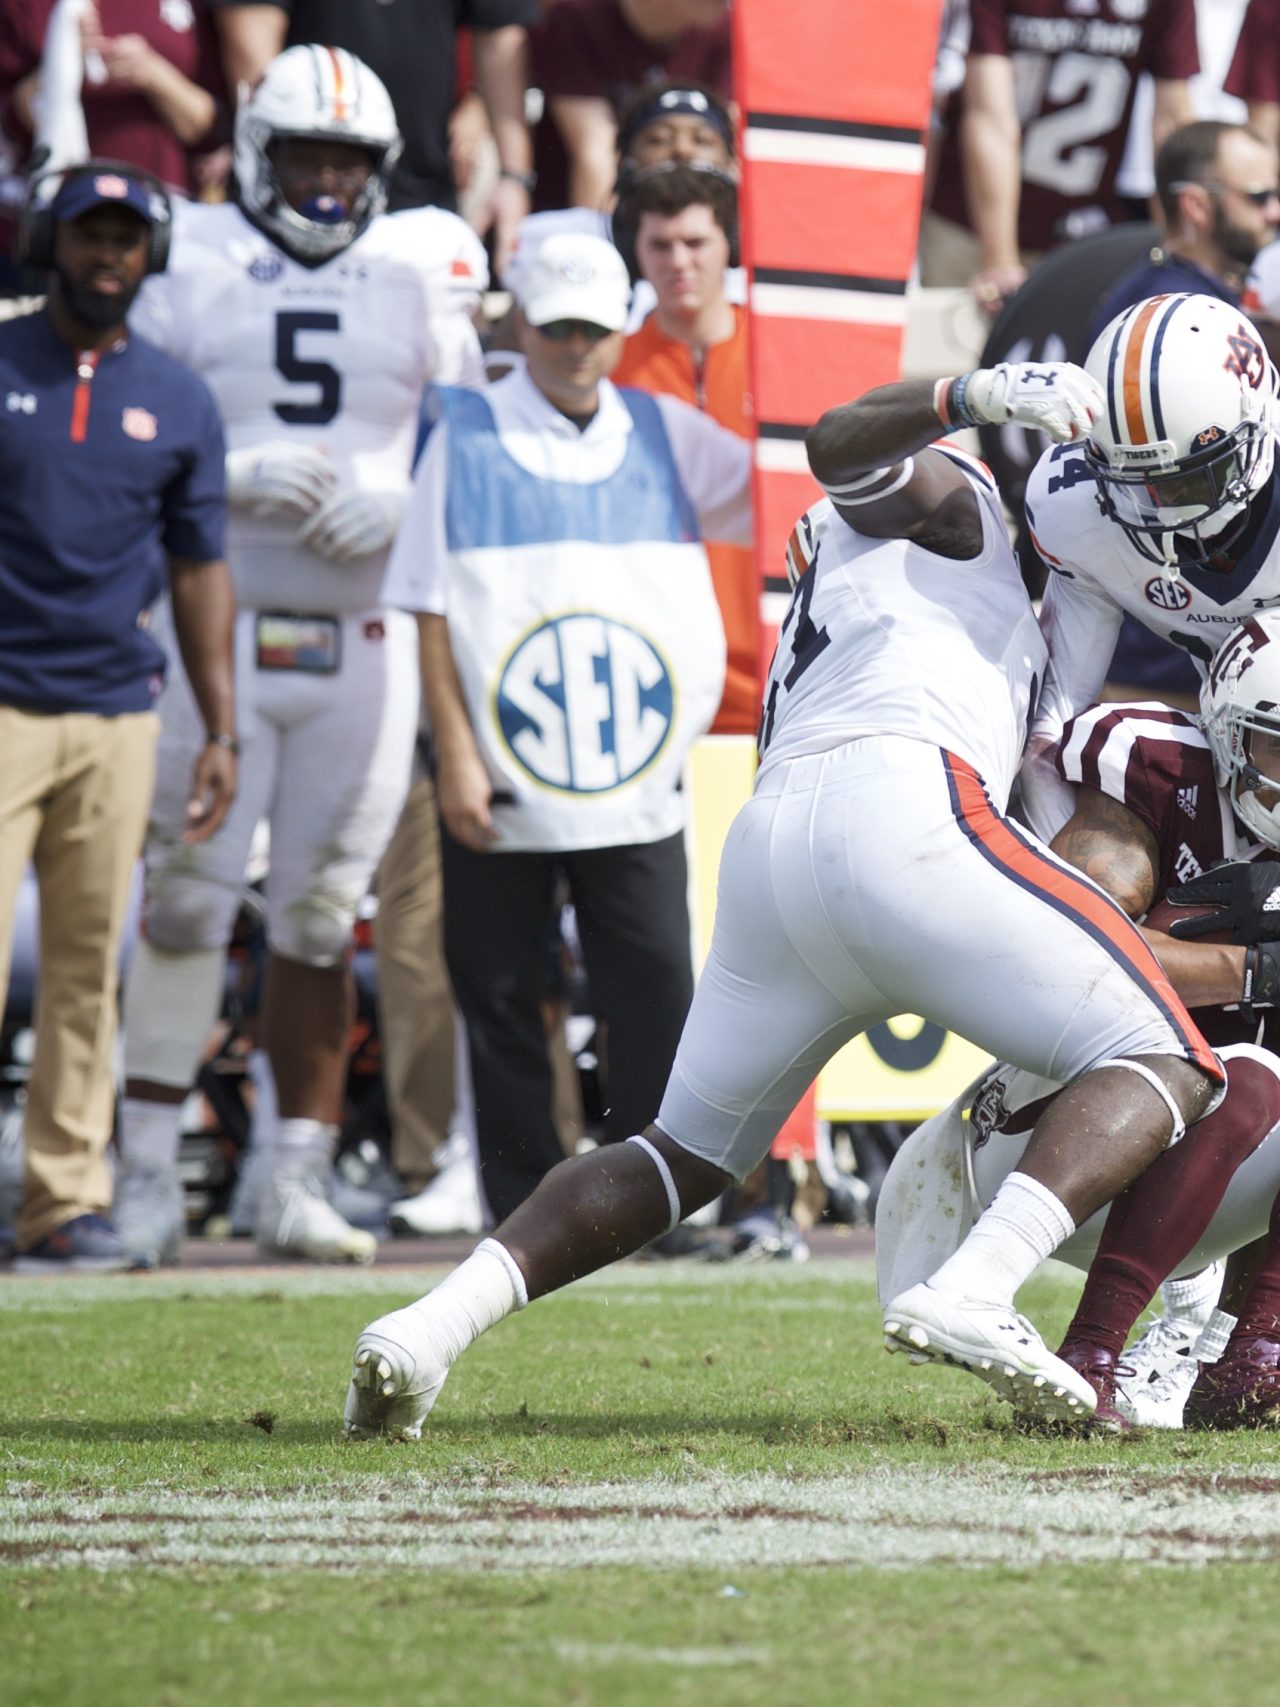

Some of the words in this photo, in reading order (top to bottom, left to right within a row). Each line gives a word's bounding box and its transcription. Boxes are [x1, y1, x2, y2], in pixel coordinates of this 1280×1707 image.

[272, 311, 341, 424] 5
[1124, 449, 1158, 460] TIGERS
[1149, 578, 1188, 609] SEC
[1186, 613, 1249, 624] AUBUR
[500, 618, 669, 789] SEC
[1175, 843, 1203, 884] TE
